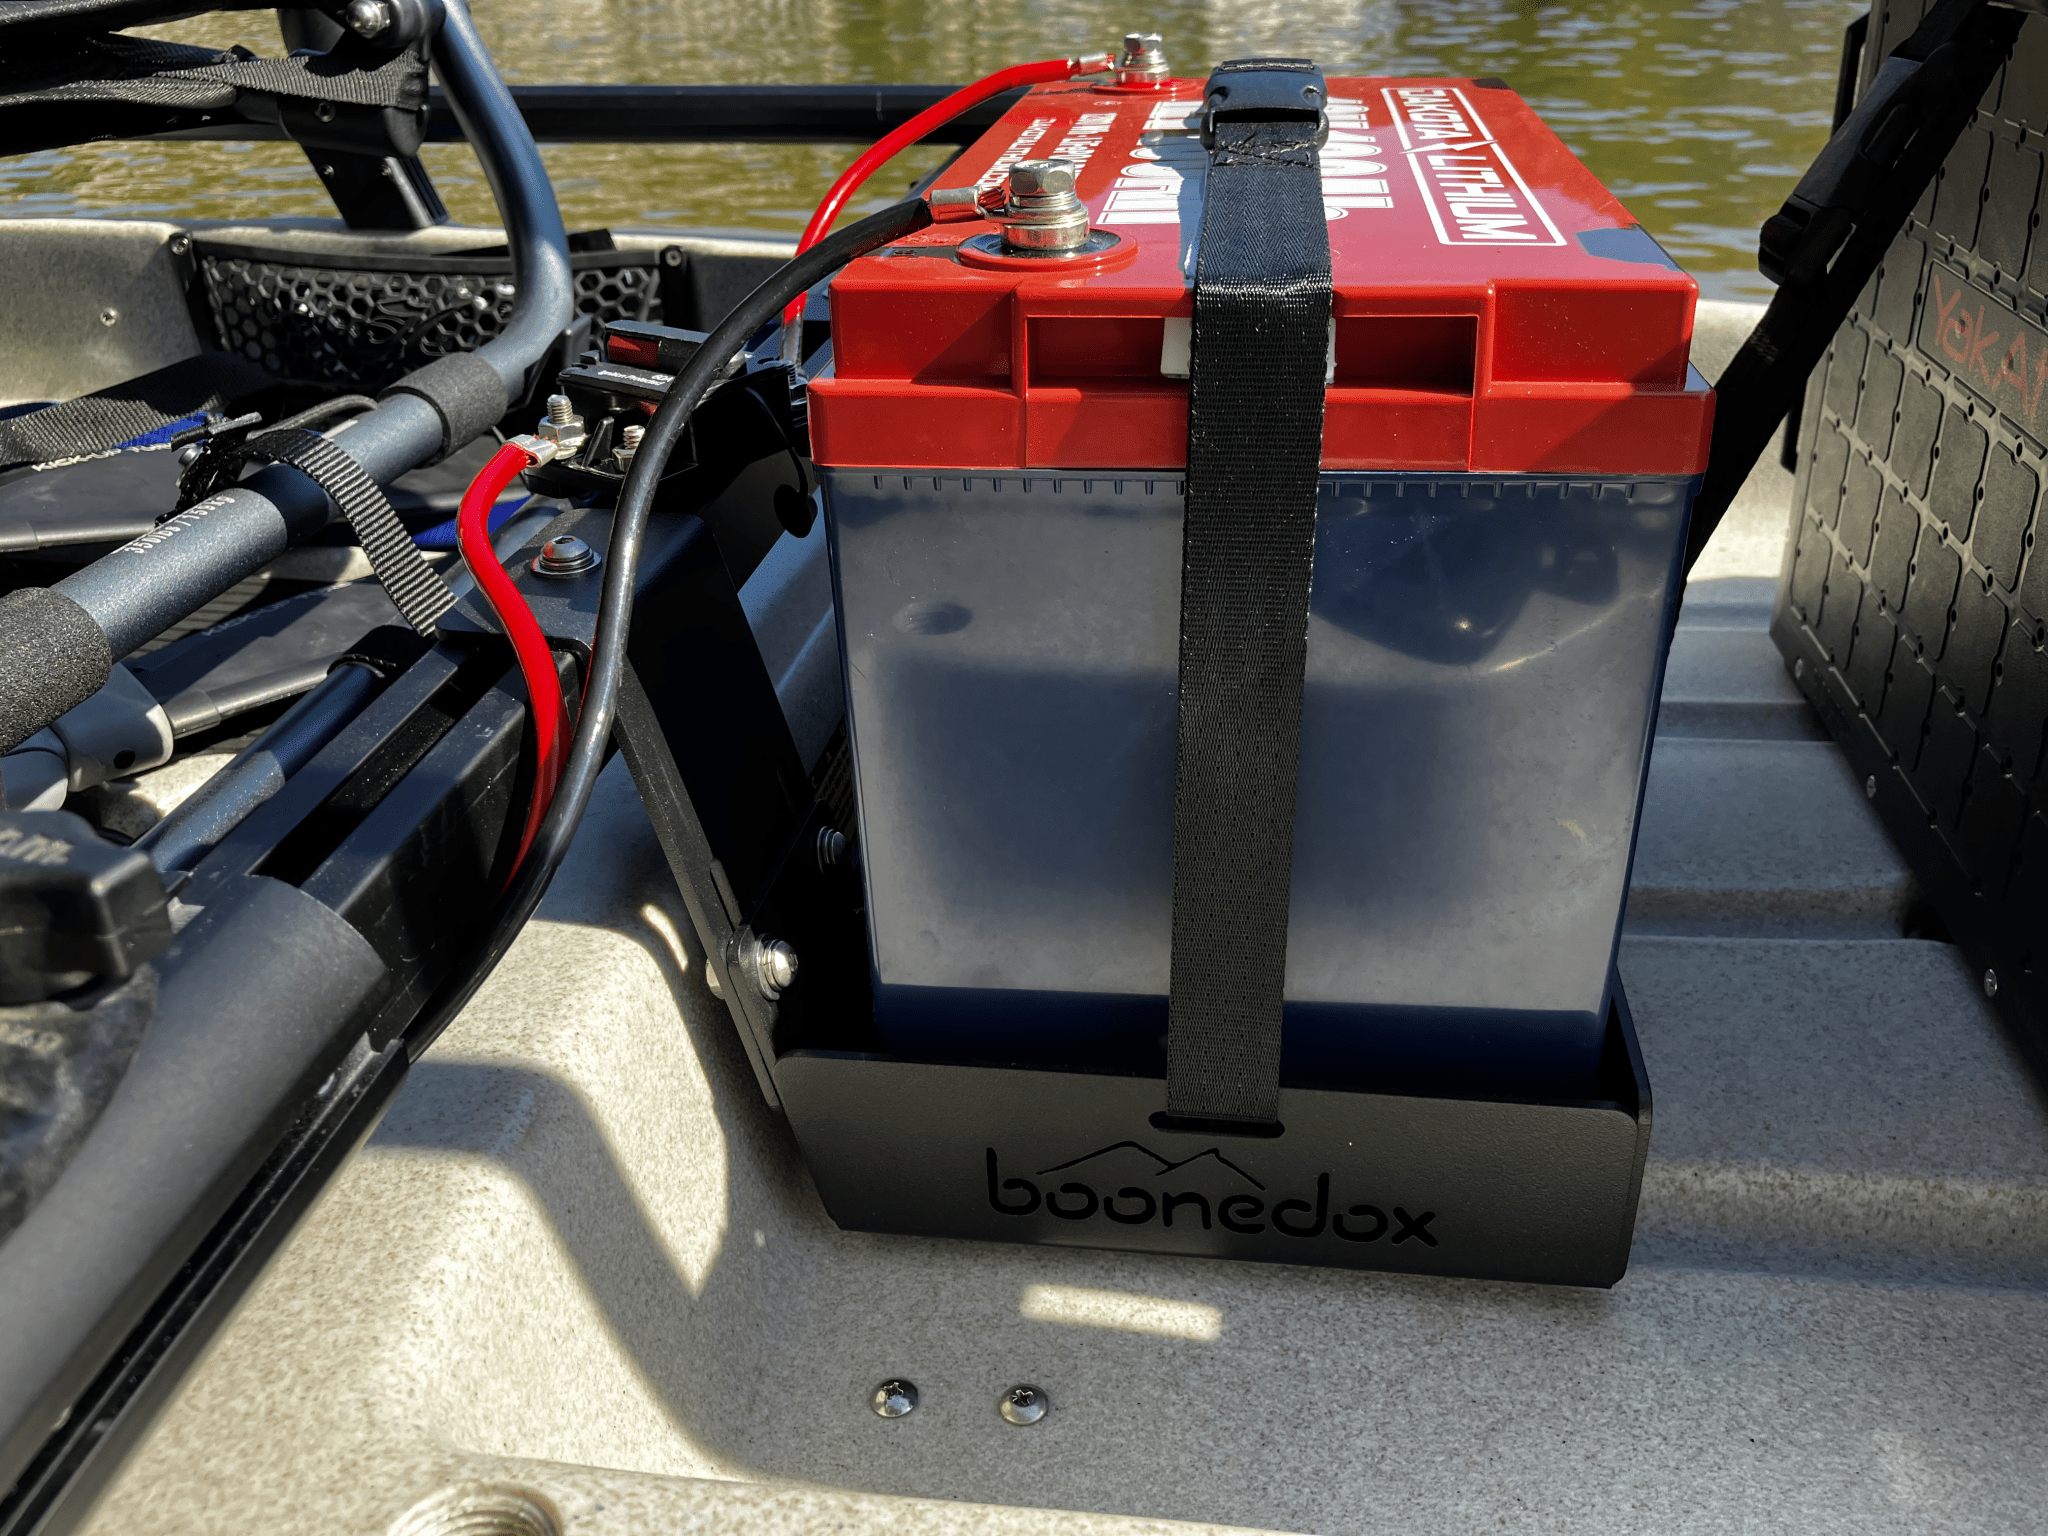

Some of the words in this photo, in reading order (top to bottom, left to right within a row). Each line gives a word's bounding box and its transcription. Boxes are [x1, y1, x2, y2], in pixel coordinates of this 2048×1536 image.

[1397, 89, 1473, 140] DAKOTA
[1427, 155, 1538, 240] LITHIUM
[985, 1146, 1439, 1248] boonedox
